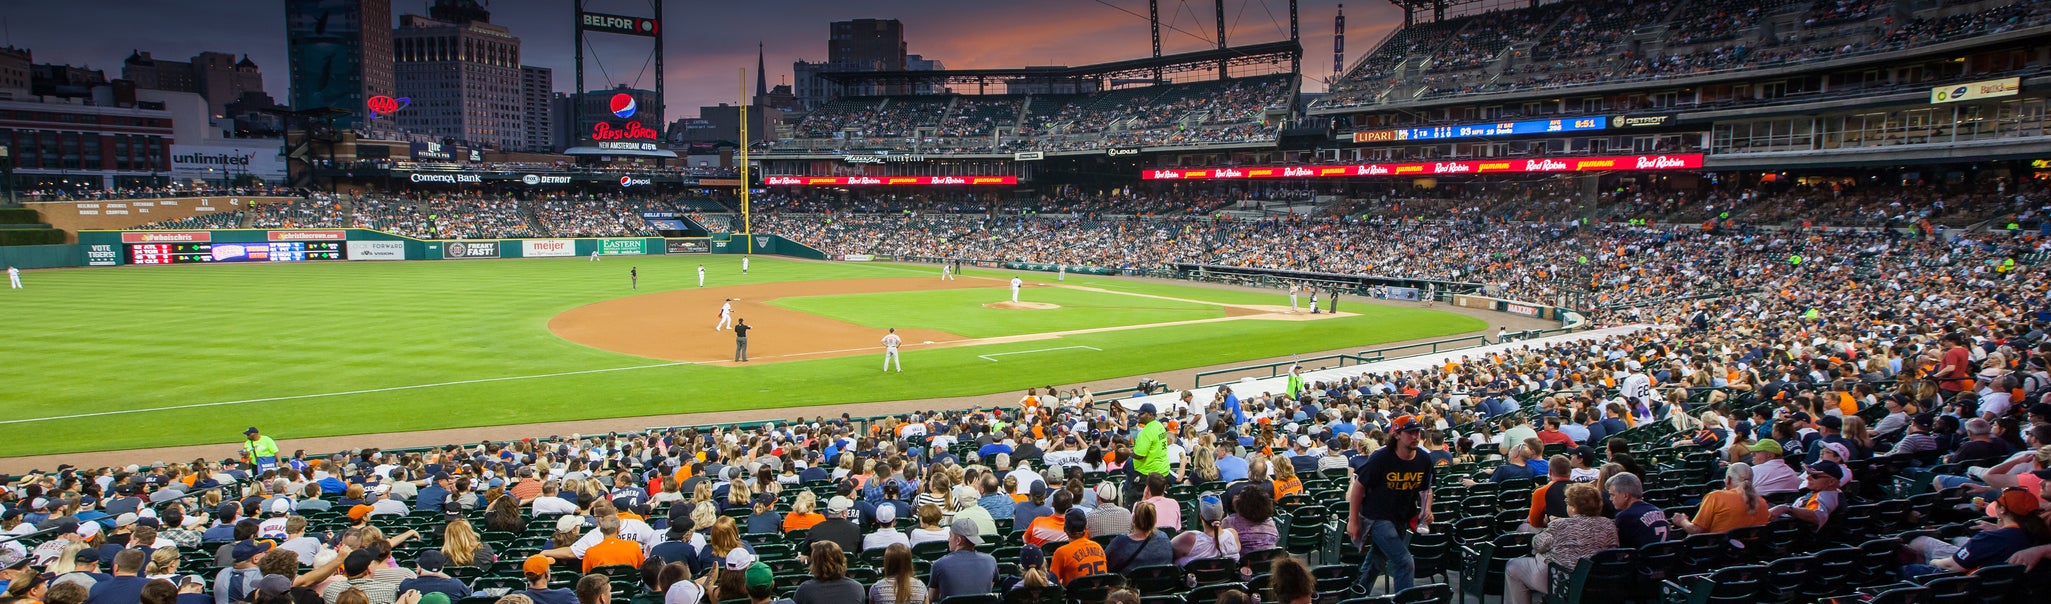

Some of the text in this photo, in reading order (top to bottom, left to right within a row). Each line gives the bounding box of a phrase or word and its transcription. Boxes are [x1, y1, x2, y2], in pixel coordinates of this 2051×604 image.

[583, 14, 633, 30] BELFOR
[1626, 115, 1668, 124] DETROIT
[1460, 127, 1471, 136] 93
[1359, 131, 1391, 142] LIPARI
[427, 141, 441, 152] Lite
[610, 141, 640, 150] AMSTERDAM
[173, 152, 249, 166] unlimited
[1636, 155, 1684, 169] Red Robin
[1434, 162, 1469, 173] Red Robin
[1525, 159, 1566, 170] Red Robin
[1154, 170, 1179, 178] Red Robin
[1214, 169, 1242, 177] Red Robin
[1283, 167, 1313, 176] Red Robin
[1357, 165, 1388, 175] Red Robin
[457, 173, 482, 183] Bank
[541, 176, 571, 184] DETROIT
[631, 178, 651, 186] pepsi
[769, 177, 782, 185] Red
[847, 177, 860, 185] Red
[931, 176, 965, 184] Red Robin
[533, 240, 564, 252] meijer
[603, 239, 641, 247] EASTERN
[467, 248, 495, 256] FAST!
[1507, 303, 1532, 315] MAXXIS
[1654, 526, 1667, 543] 7
